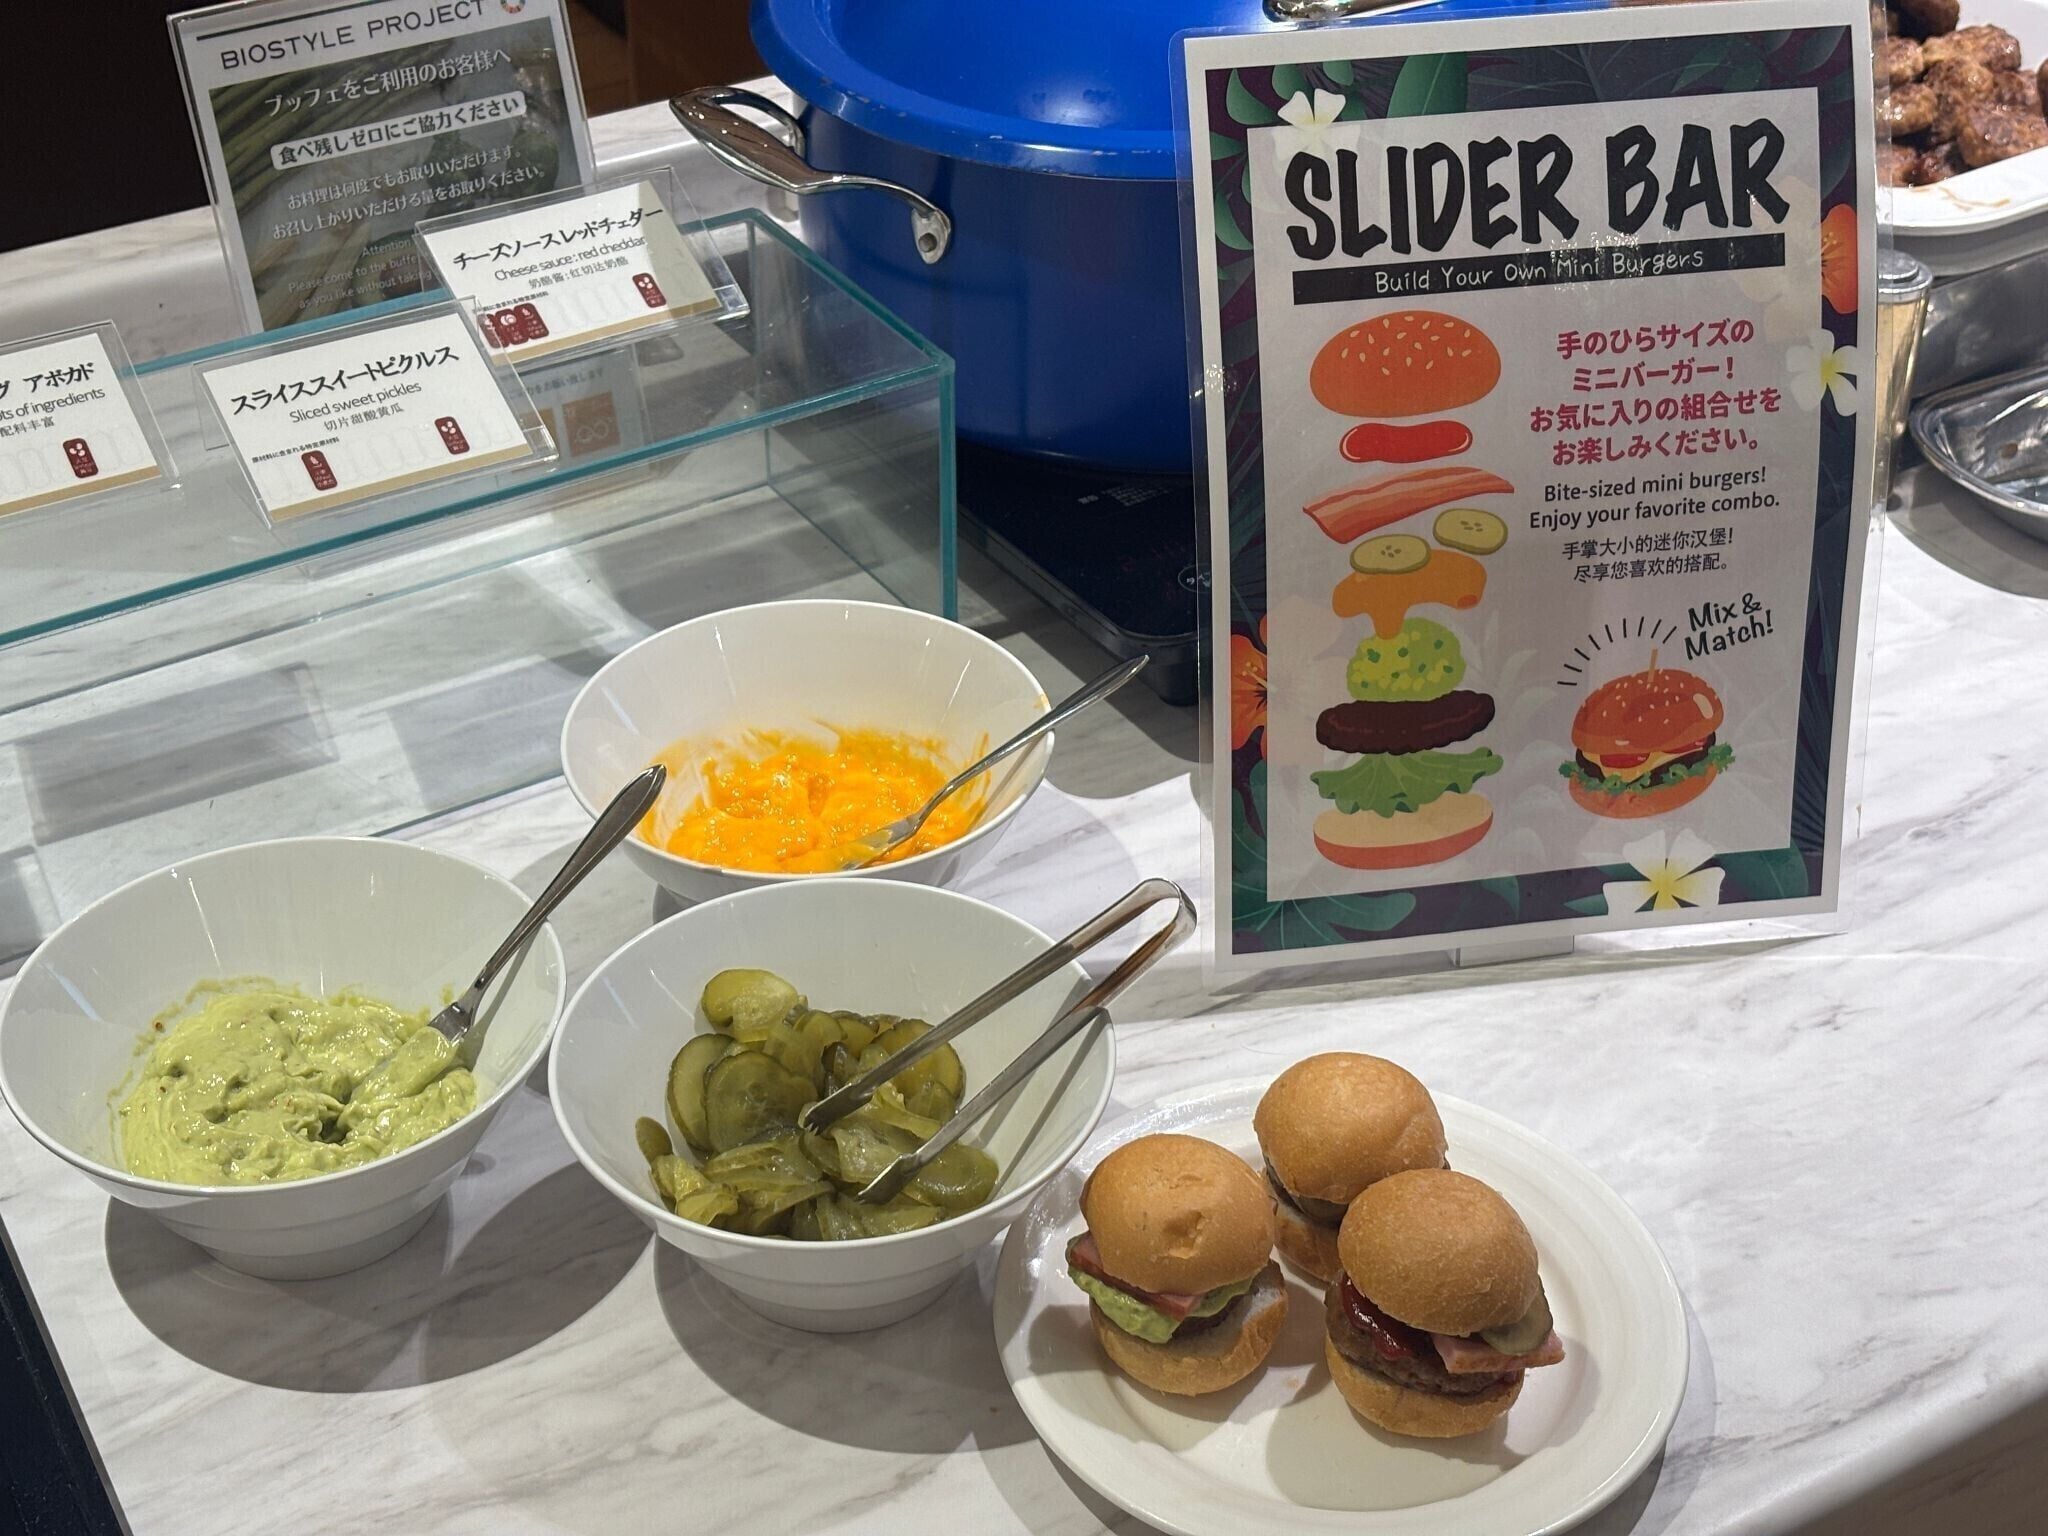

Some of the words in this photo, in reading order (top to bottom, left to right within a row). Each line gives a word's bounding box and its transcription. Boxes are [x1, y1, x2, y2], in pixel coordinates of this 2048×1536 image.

[221, 25, 354, 70] BIOSTYLE
[368, 0, 485, 38] PROJECT
[264, 48, 512, 117] ブッフェをご利用のお客様へ
[278, 97, 520, 165] 食べ残しゼロにご協力ください
[287, 144, 522, 210] お料理は何度でもお取りいただけます。
[1284, 133, 1580, 261] SLIDER
[1606, 117, 1791, 235] BAR
[272, 164, 546, 240] お召し上がりいただける量をお取りください。
[361, 238, 411, 257] Attention
[494, 262, 539, 282] Cheese
[578, 245, 598, 262] red
[598, 235, 647, 256] cheddar
[288, 277, 323, 293] Please
[324, 271, 352, 284] come
[356, 266, 367, 276] to
[370, 260, 386, 273] the
[356, 277, 396, 294] without
[1375, 269, 1430, 295] Build
[1441, 266, 1494, 289] Your
[1504, 263, 1547, 283] Own
[1556, 255, 1600, 278] Mini
[1612, 249, 1704, 278] Burgers
[1556, 317, 1755, 360] 手のひらサイズの
[22, 362, 95, 393] アボカド
[230, 346, 460, 415] スライススイートピクルス
[1572, 356, 1734, 392] ミニバーガー!
[16, 402, 30, 417] of
[30, 388, 106, 414] ingredients
[289, 403, 331, 424] Sliced
[332, 392, 375, 413] sweet
[376, 380, 422, 404] pickles
[323, 402, 405, 432] 切片甜酸黄瓜
[1530, 386, 1782, 432] お気に入りの組合せを
[1552, 427, 1758, 466] お楽しみください。
[1544, 476, 1636, 503] Bite-sized
[1642, 472, 1683, 494] mini
[1689, 466, 1766, 492] burgers!
[1530, 509, 1582, 532] Enjoy
[1587, 505, 1630, 529] your
[1635, 496, 1706, 520] favorite
[1711, 491, 1780, 512] combo.
[1562, 527, 1734, 561] 手掌大小的迷你汉堡!
[1573, 552, 1728, 584] 尽享您喜欢的搭配。
[1687, 601, 1738, 632] Mix
[1742, 592, 1763, 614] &
[1684, 609, 1775, 661] Match!
